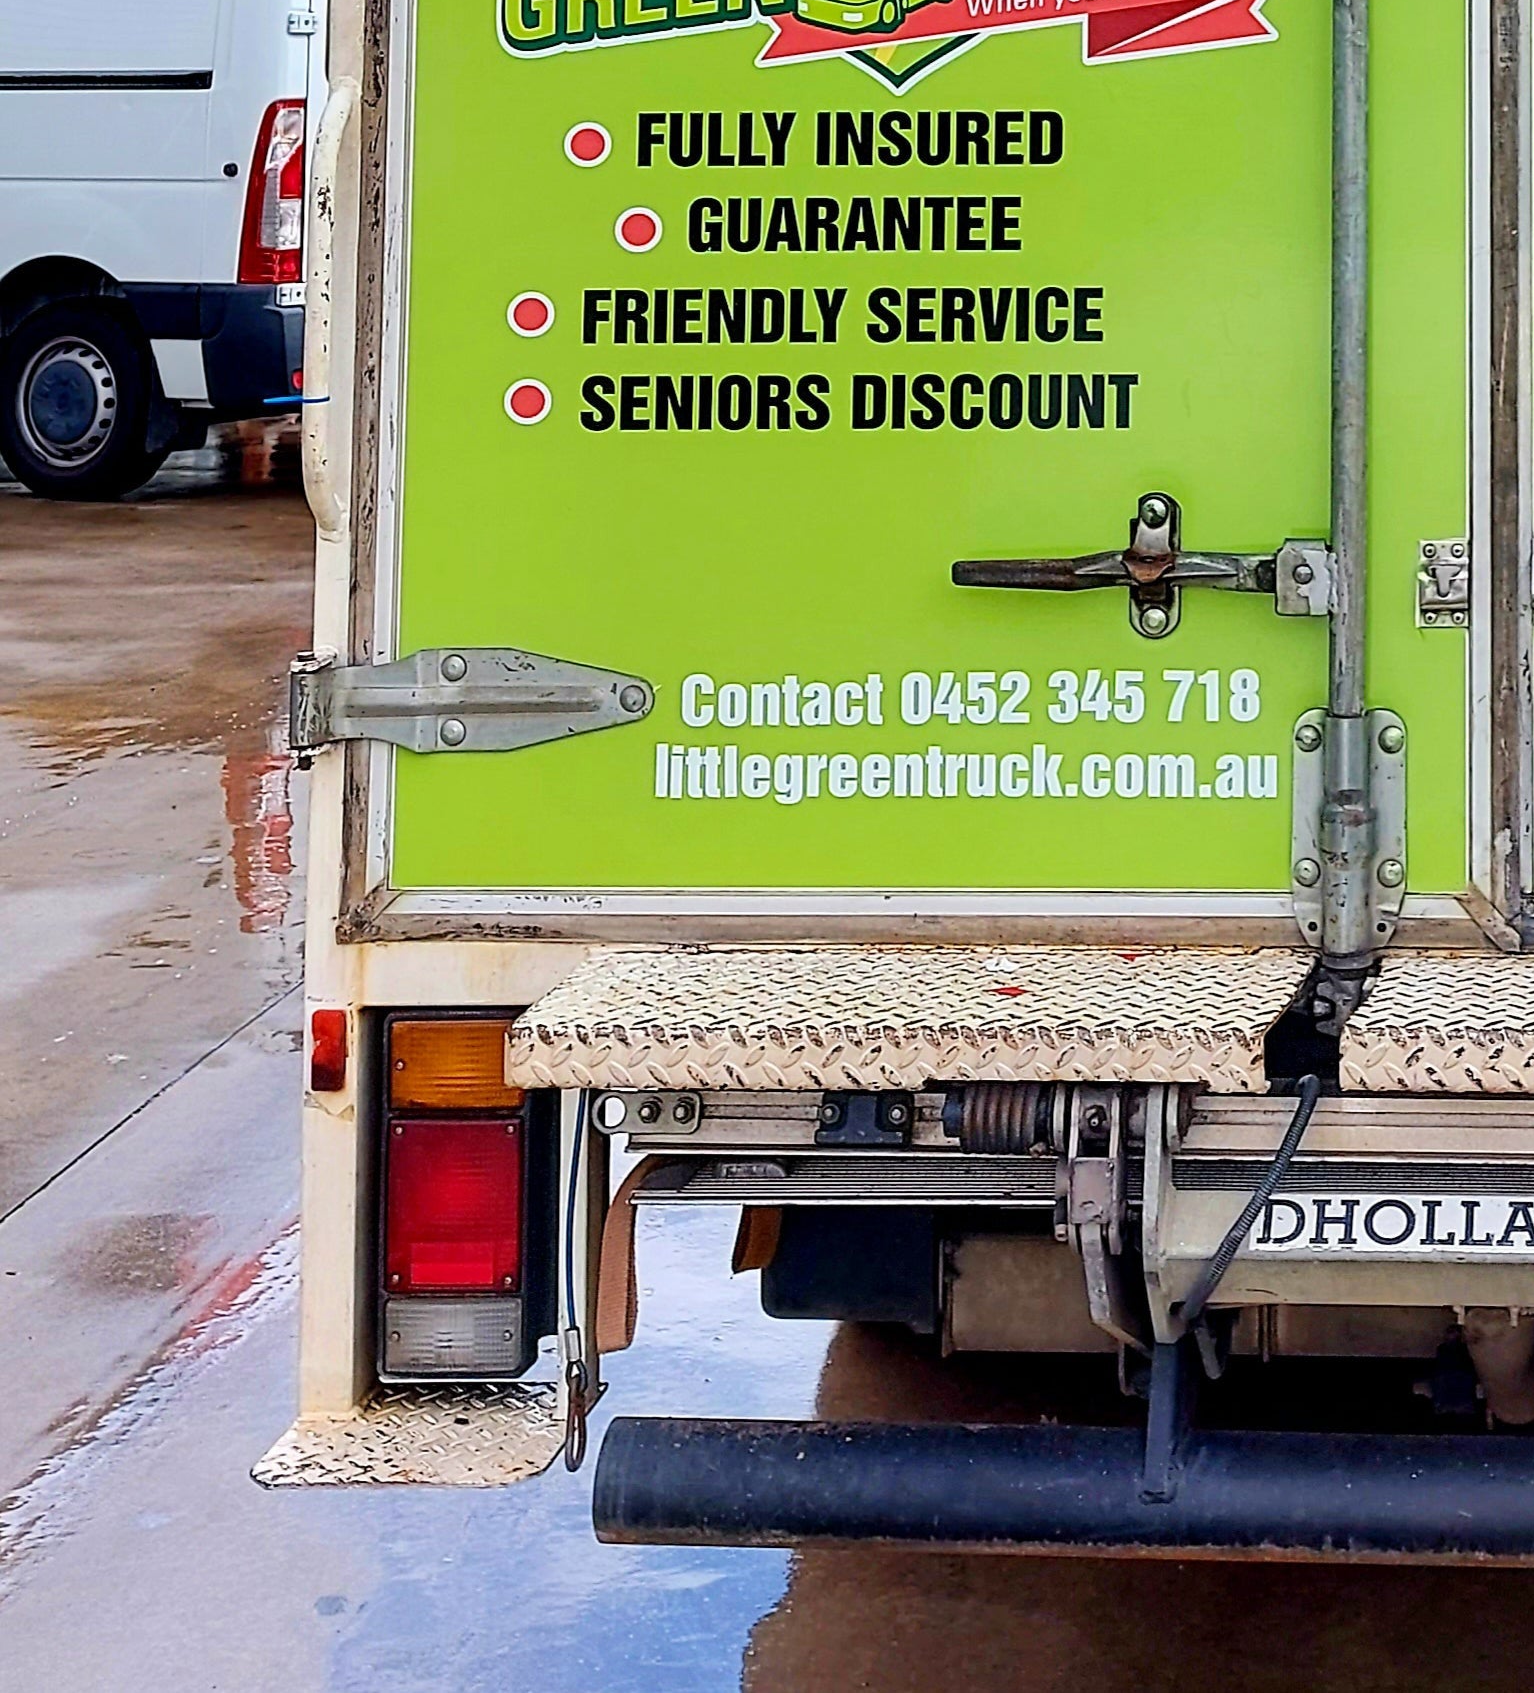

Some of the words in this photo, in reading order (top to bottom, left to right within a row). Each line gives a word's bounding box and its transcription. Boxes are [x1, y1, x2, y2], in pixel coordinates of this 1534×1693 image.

[636, 110, 796, 168] FULLY
[815, 110, 1065, 167] INSURED
[687, 196, 1023, 253] GUARANTEE
[581, 287, 848, 345] FRIENDLY
[866, 286, 1105, 344] SERVICE
[579, 374, 830, 432] SENIORS
[852, 373, 1139, 431] DISCOUNT
[680, 672, 884, 728] Contact
[900, 670, 1031, 727] 0452
[1046, 668, 1146, 724] 345
[1163, 667, 1262, 723] 718
[654, 742, 1278, 805] littlegreentruck.com.au
